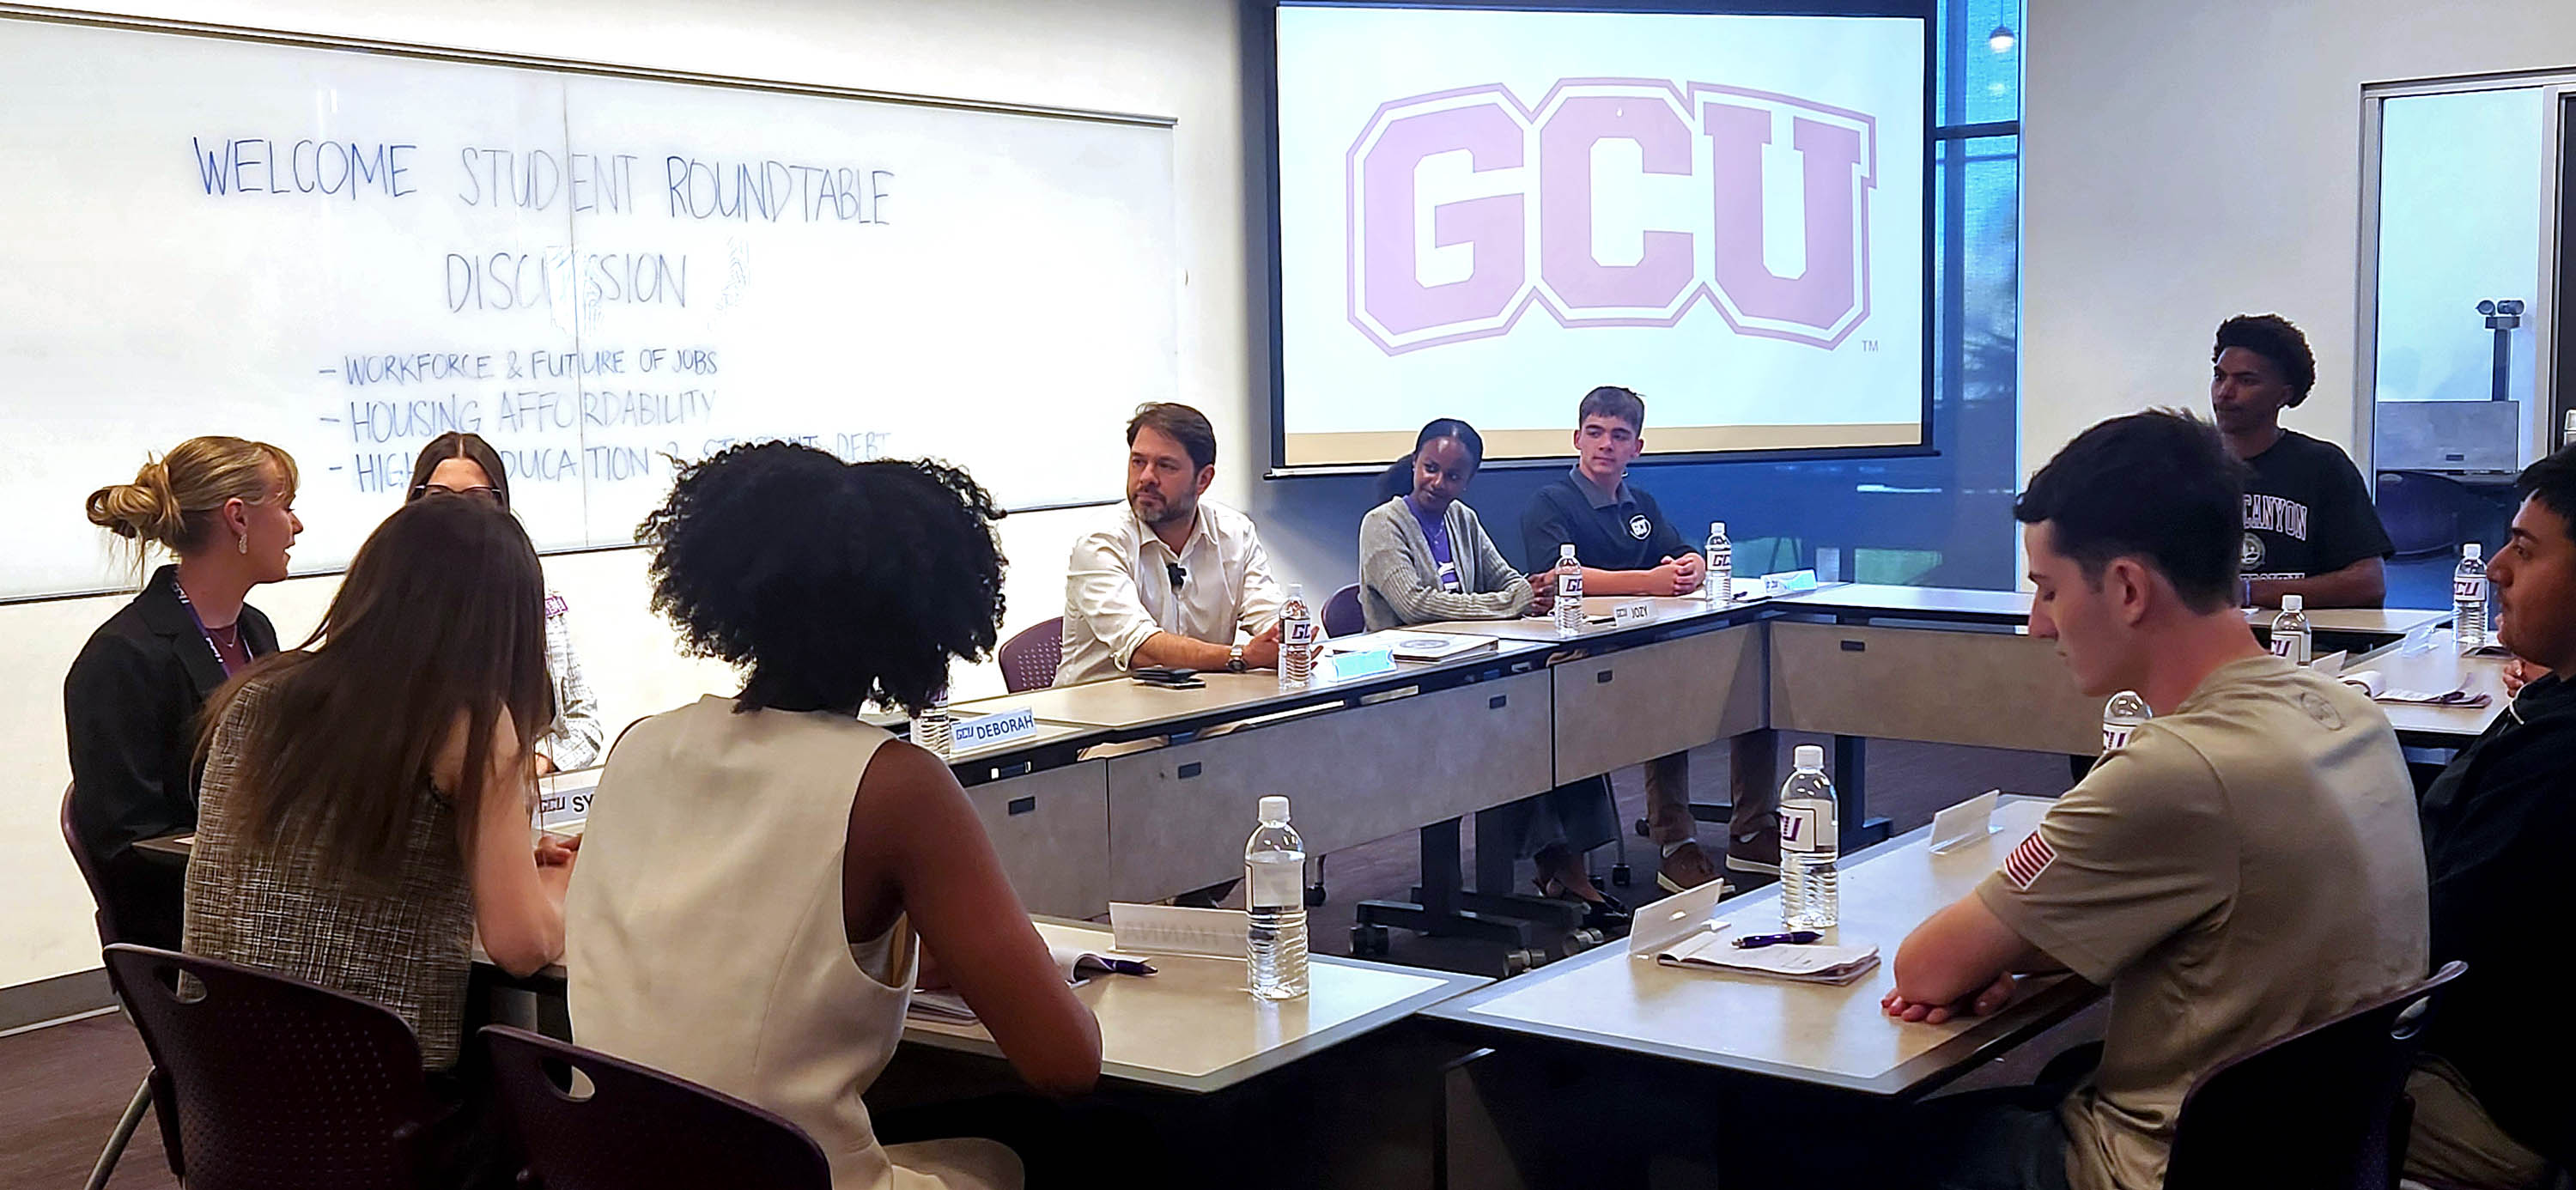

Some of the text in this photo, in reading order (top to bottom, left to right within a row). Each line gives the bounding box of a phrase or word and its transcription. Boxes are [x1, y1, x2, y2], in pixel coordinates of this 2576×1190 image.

[194, 137, 895, 225] WELCOME STUDENT ROUNDTABLE
[1346, 77, 1877, 355] GCU
[447, 252, 686, 313] DISCSSION
[507, 350, 522, 379] &
[532, 350, 625, 379] FUTURE
[640, 349, 666, 373] OF
[672, 349, 718, 375] JOBS
[1862, 340, 1879, 352] TM
[350, 393, 481, 443] HOUSING
[499, 390, 717, 433] AFFORDABILITY
[501, 446, 650, 482] DUCATION
[2453, 580, 2480, 596] CU
[956, 714, 1035, 740] GCU DEBORAH
